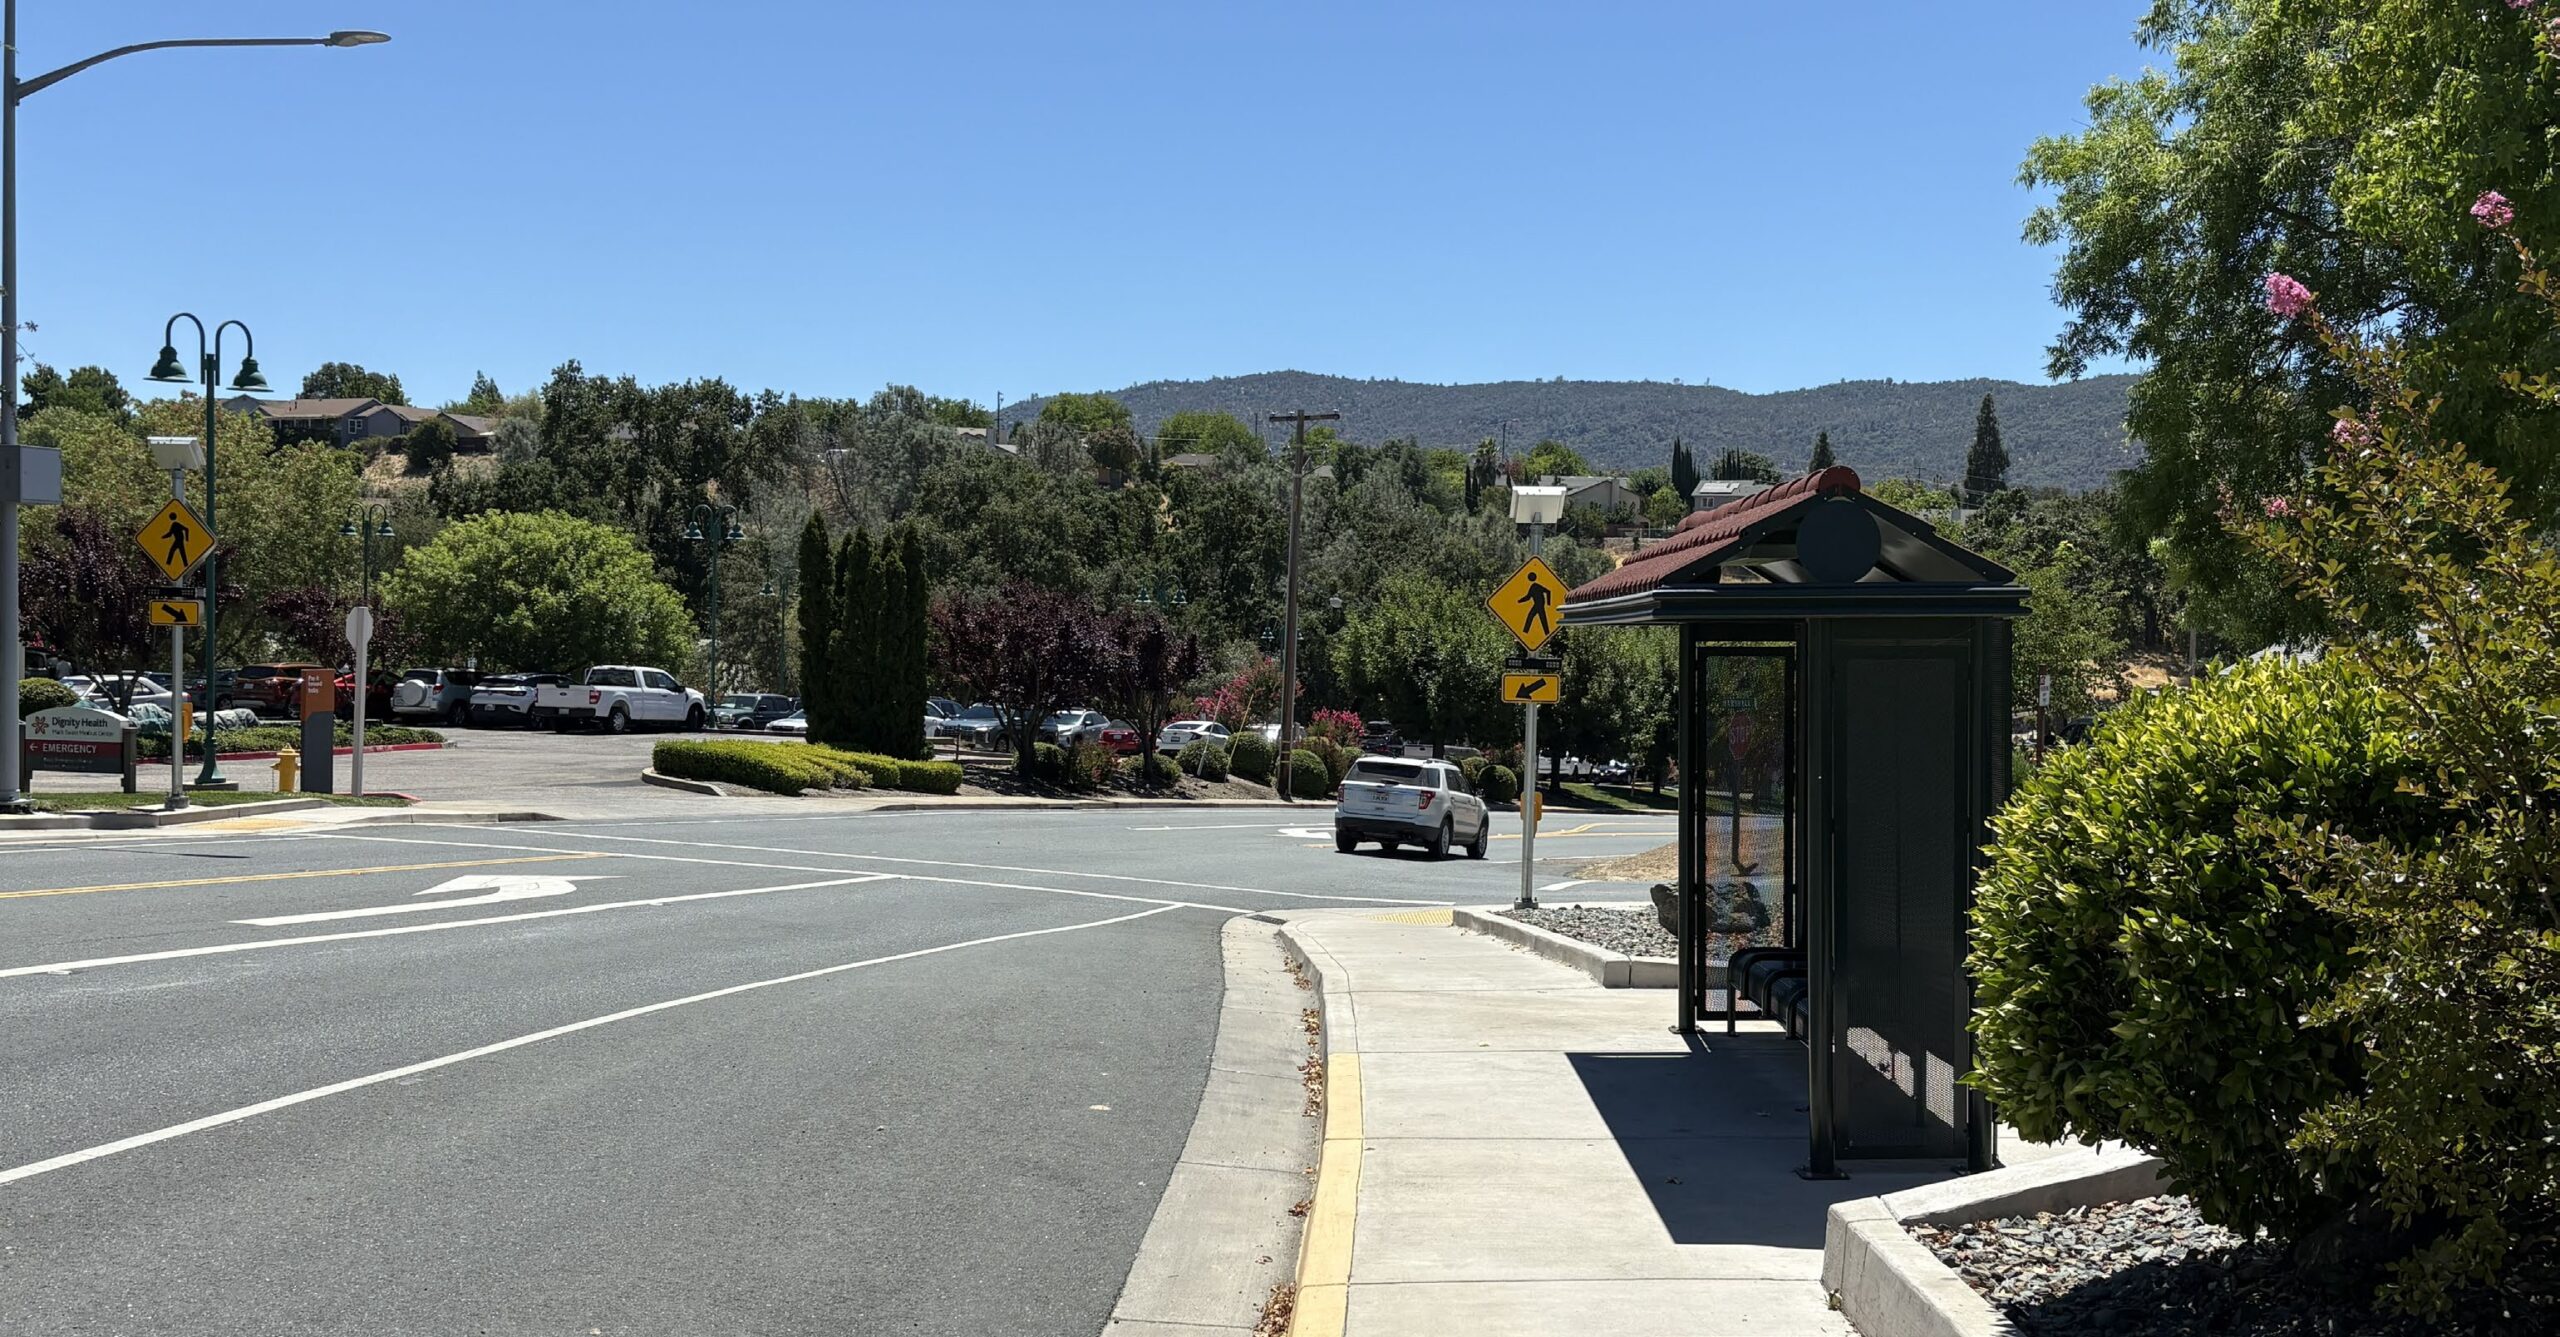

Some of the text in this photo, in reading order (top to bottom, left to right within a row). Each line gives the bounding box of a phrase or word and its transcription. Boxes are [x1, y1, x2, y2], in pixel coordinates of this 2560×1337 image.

[52, 717, 108, 728] Dignity Health
[43, 744, 97, 753] EMERGENCY
